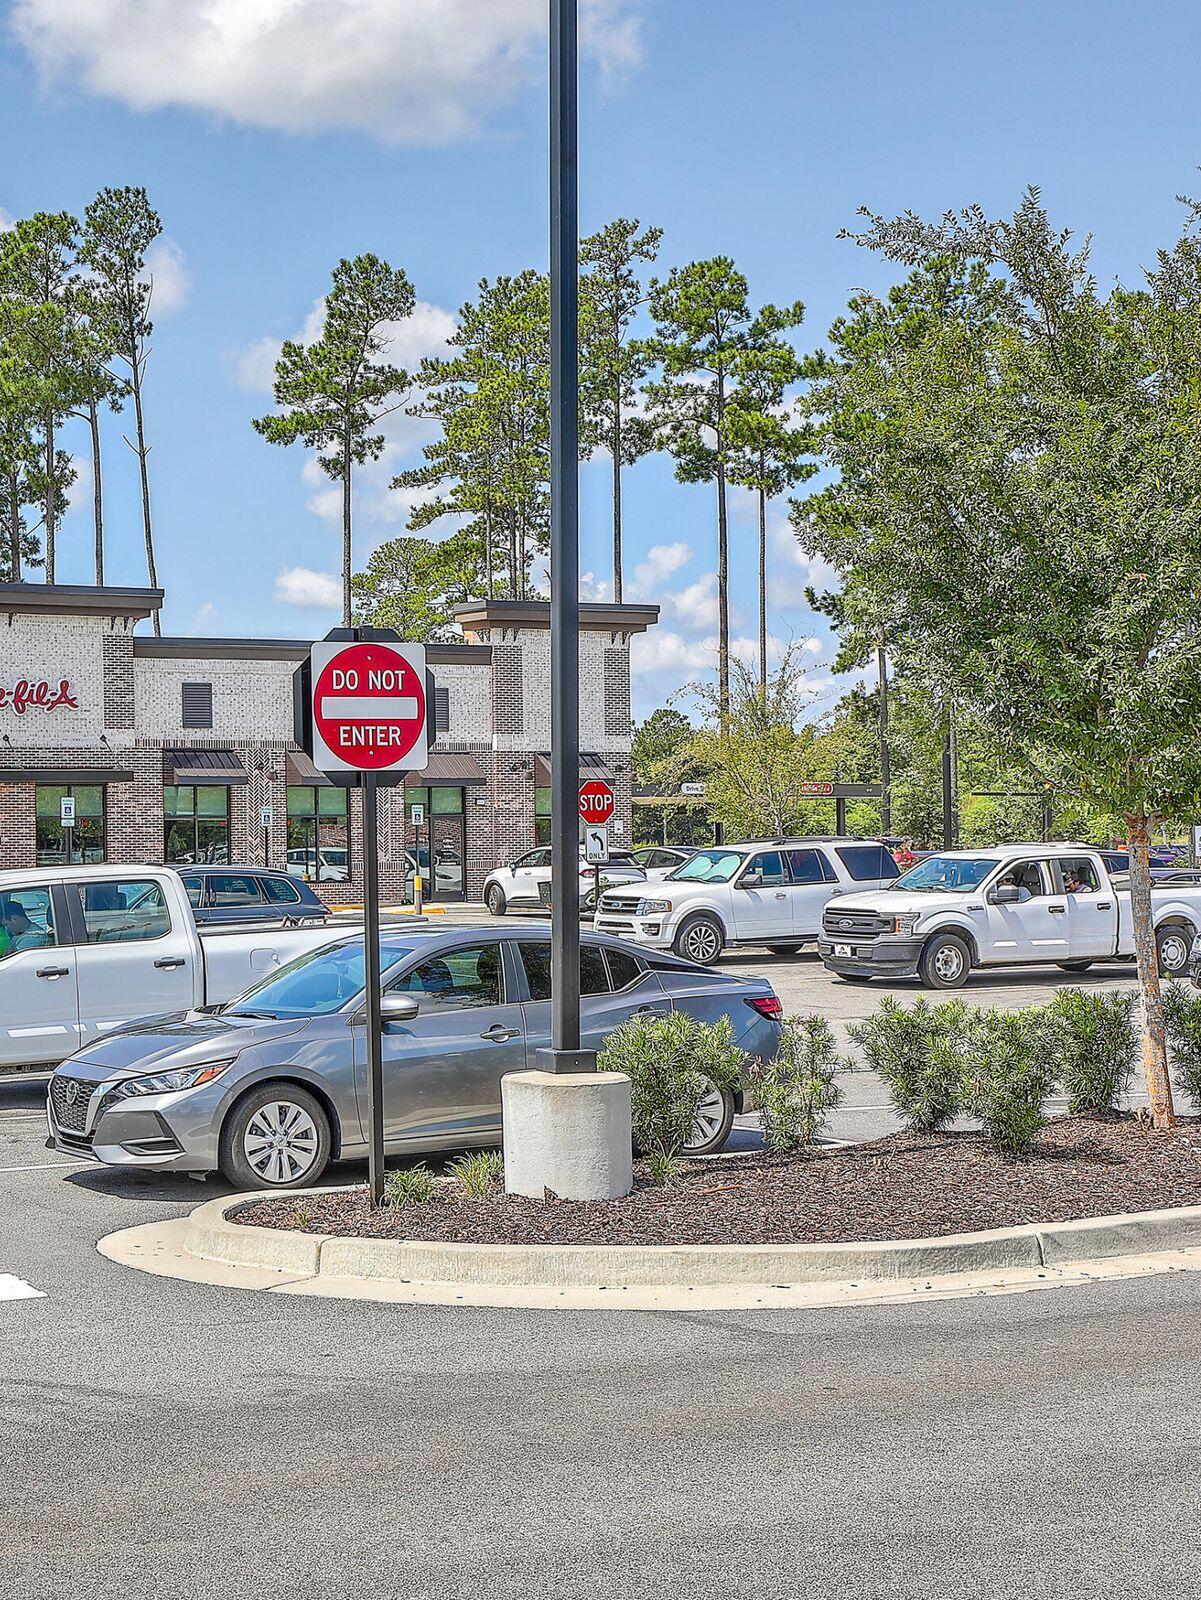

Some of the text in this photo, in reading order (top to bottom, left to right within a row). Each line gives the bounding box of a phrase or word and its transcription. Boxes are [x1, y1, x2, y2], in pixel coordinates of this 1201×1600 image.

[332, 669, 406, 691] DO NOT
[338, 725, 402, 747] ENTER
[579, 794, 613, 812] STOP
[588, 852, 606, 860] ONLY
